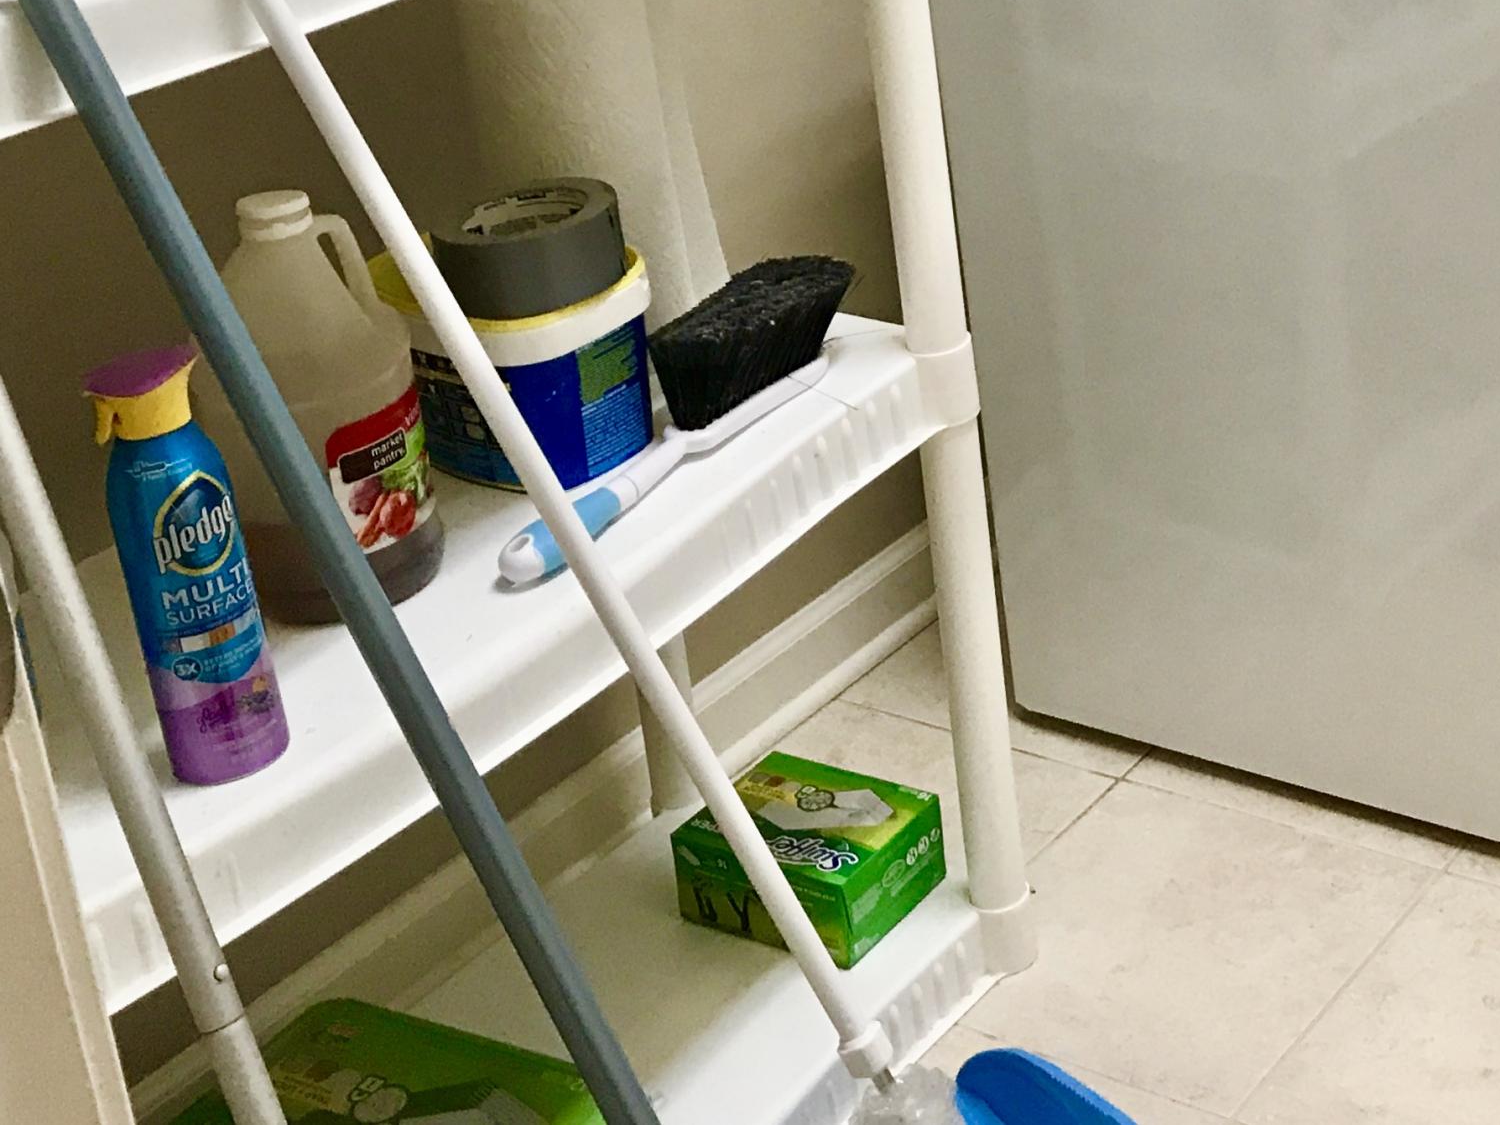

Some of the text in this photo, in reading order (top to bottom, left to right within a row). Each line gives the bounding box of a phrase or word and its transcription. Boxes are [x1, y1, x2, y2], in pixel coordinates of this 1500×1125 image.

[370, 432, 404, 457] market
[153, 494, 234, 575] pledge
[161, 557, 250, 610] MULTI
[166, 578, 253, 625] SURFACE
